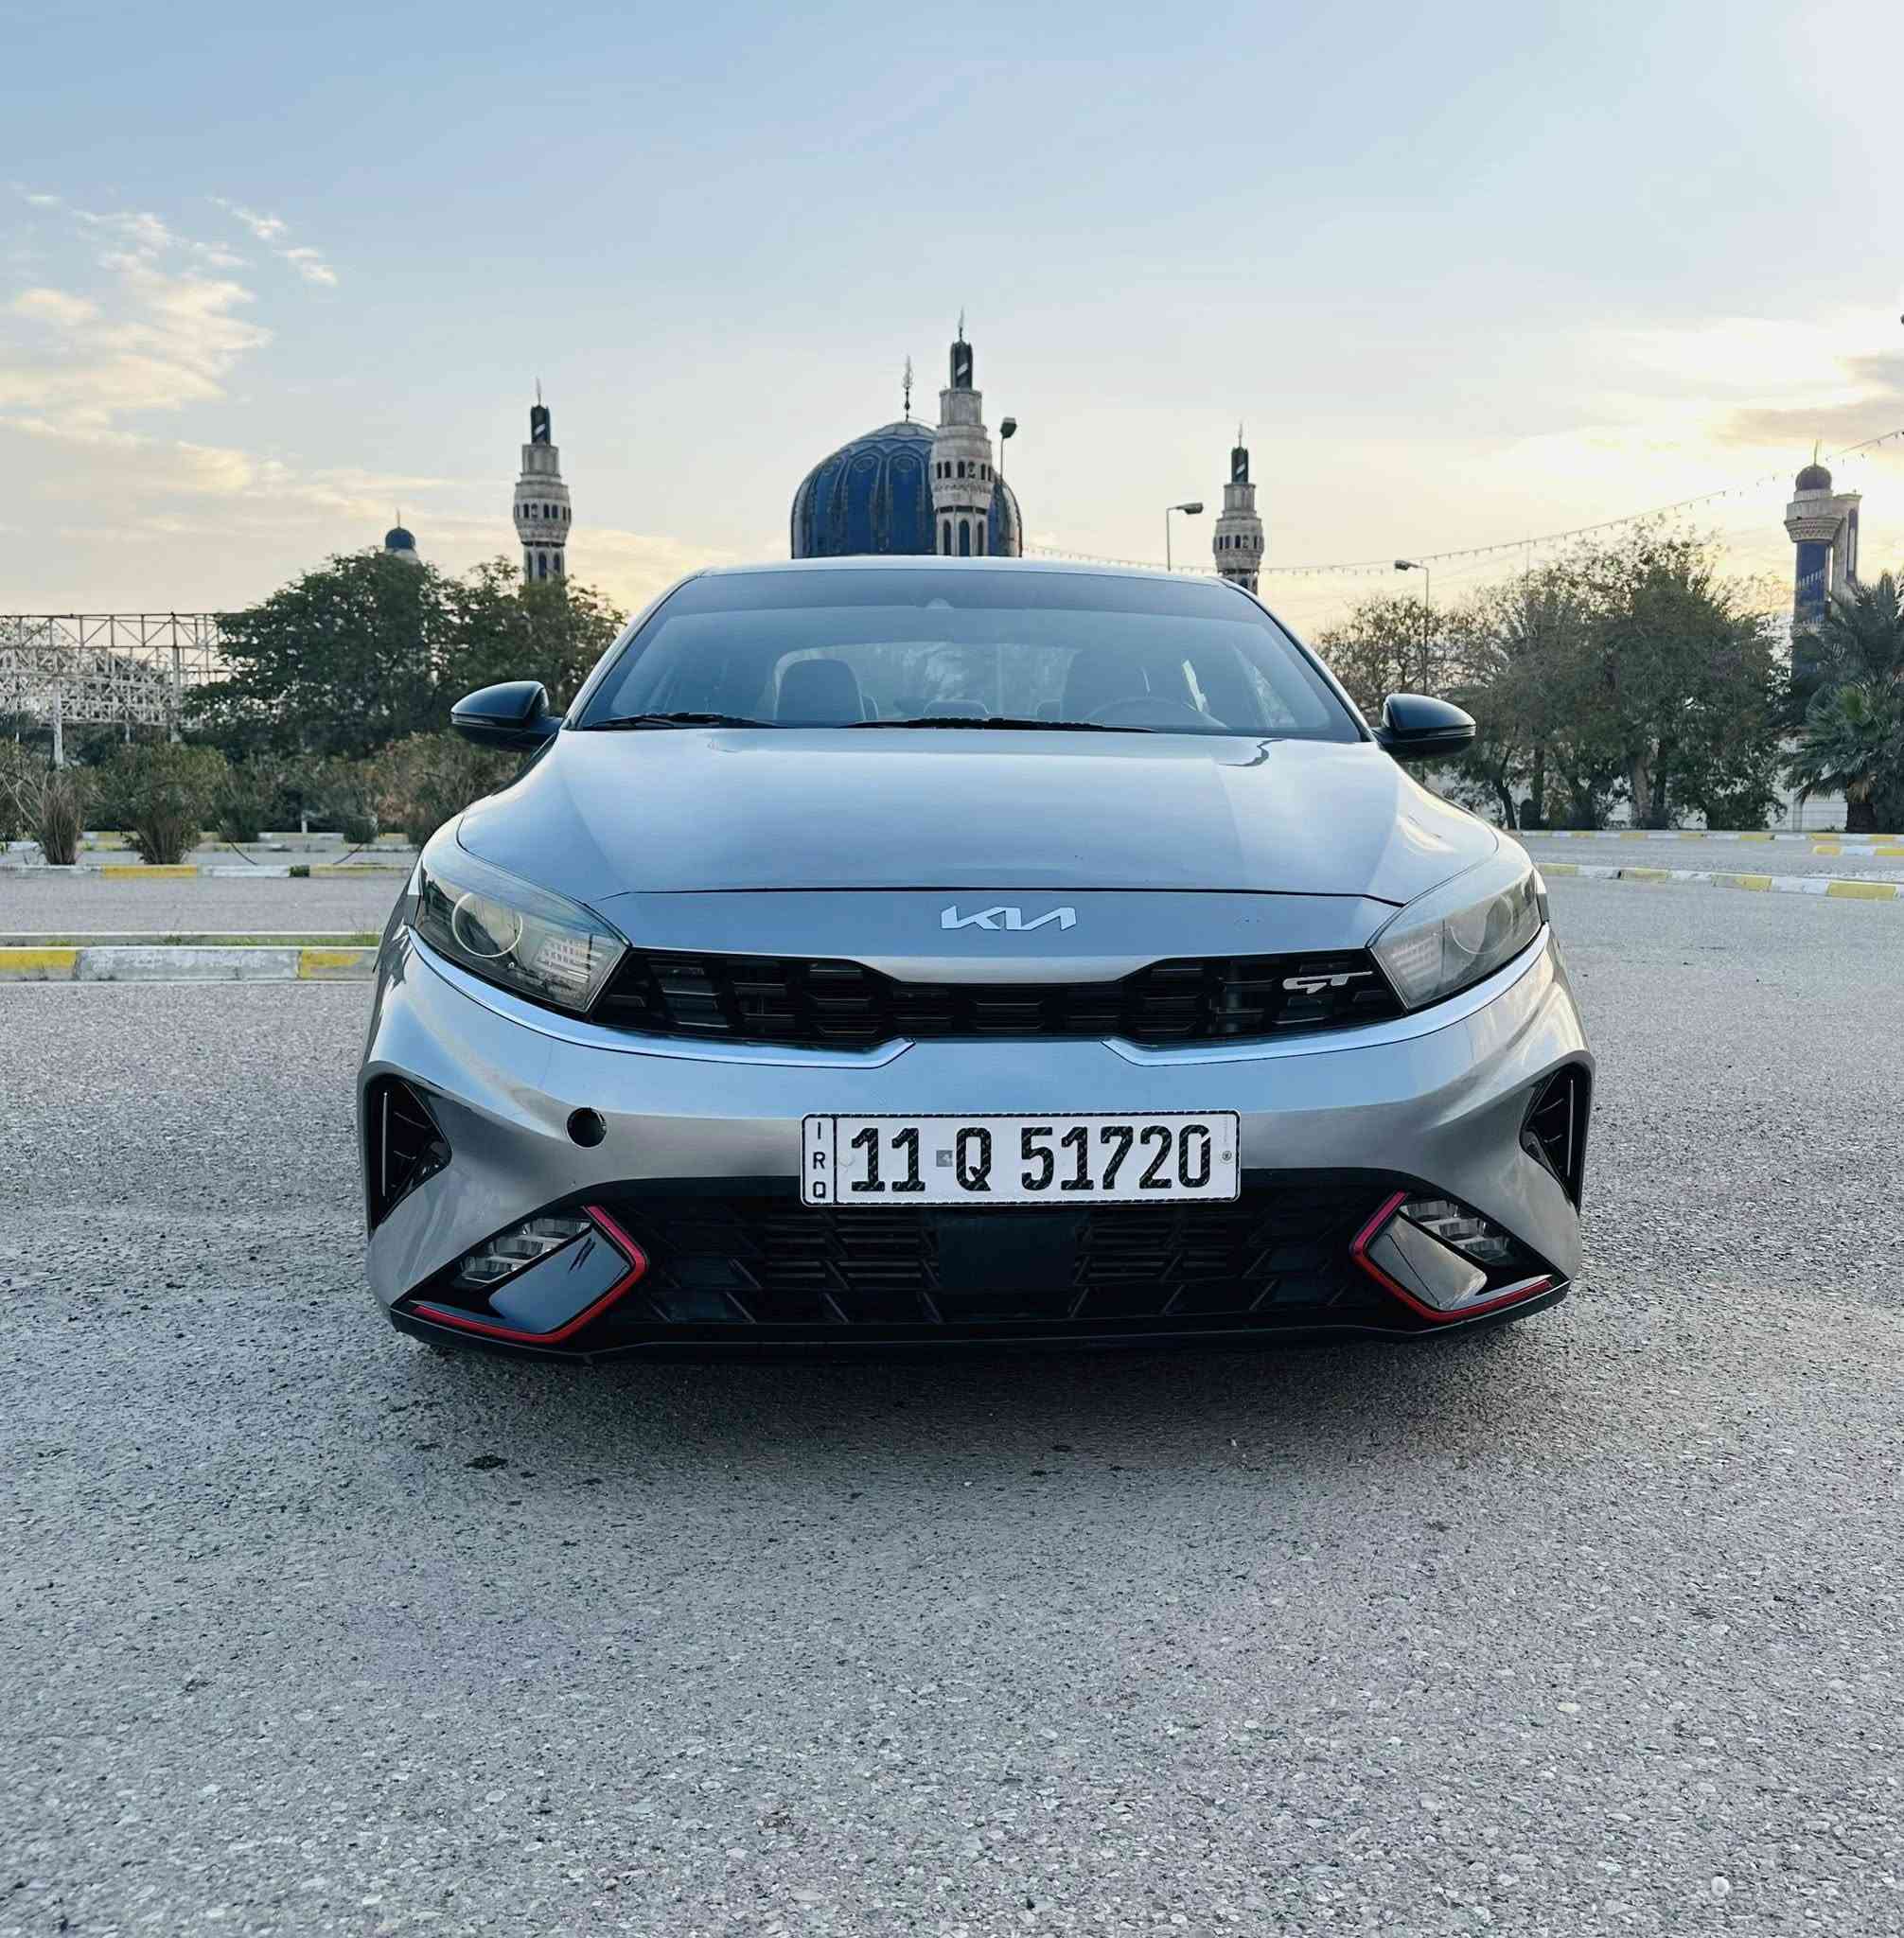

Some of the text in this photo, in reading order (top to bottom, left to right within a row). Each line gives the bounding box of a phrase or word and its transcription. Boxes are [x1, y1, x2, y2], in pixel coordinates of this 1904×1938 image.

[941, 906, 1077, 931] KIA
[1282, 971, 1374, 994] GT
[851, 1126, 926, 1192] 11
[955, 1125, 992, 1191] Q
[1020, 1124, 1212, 1191] 51720
